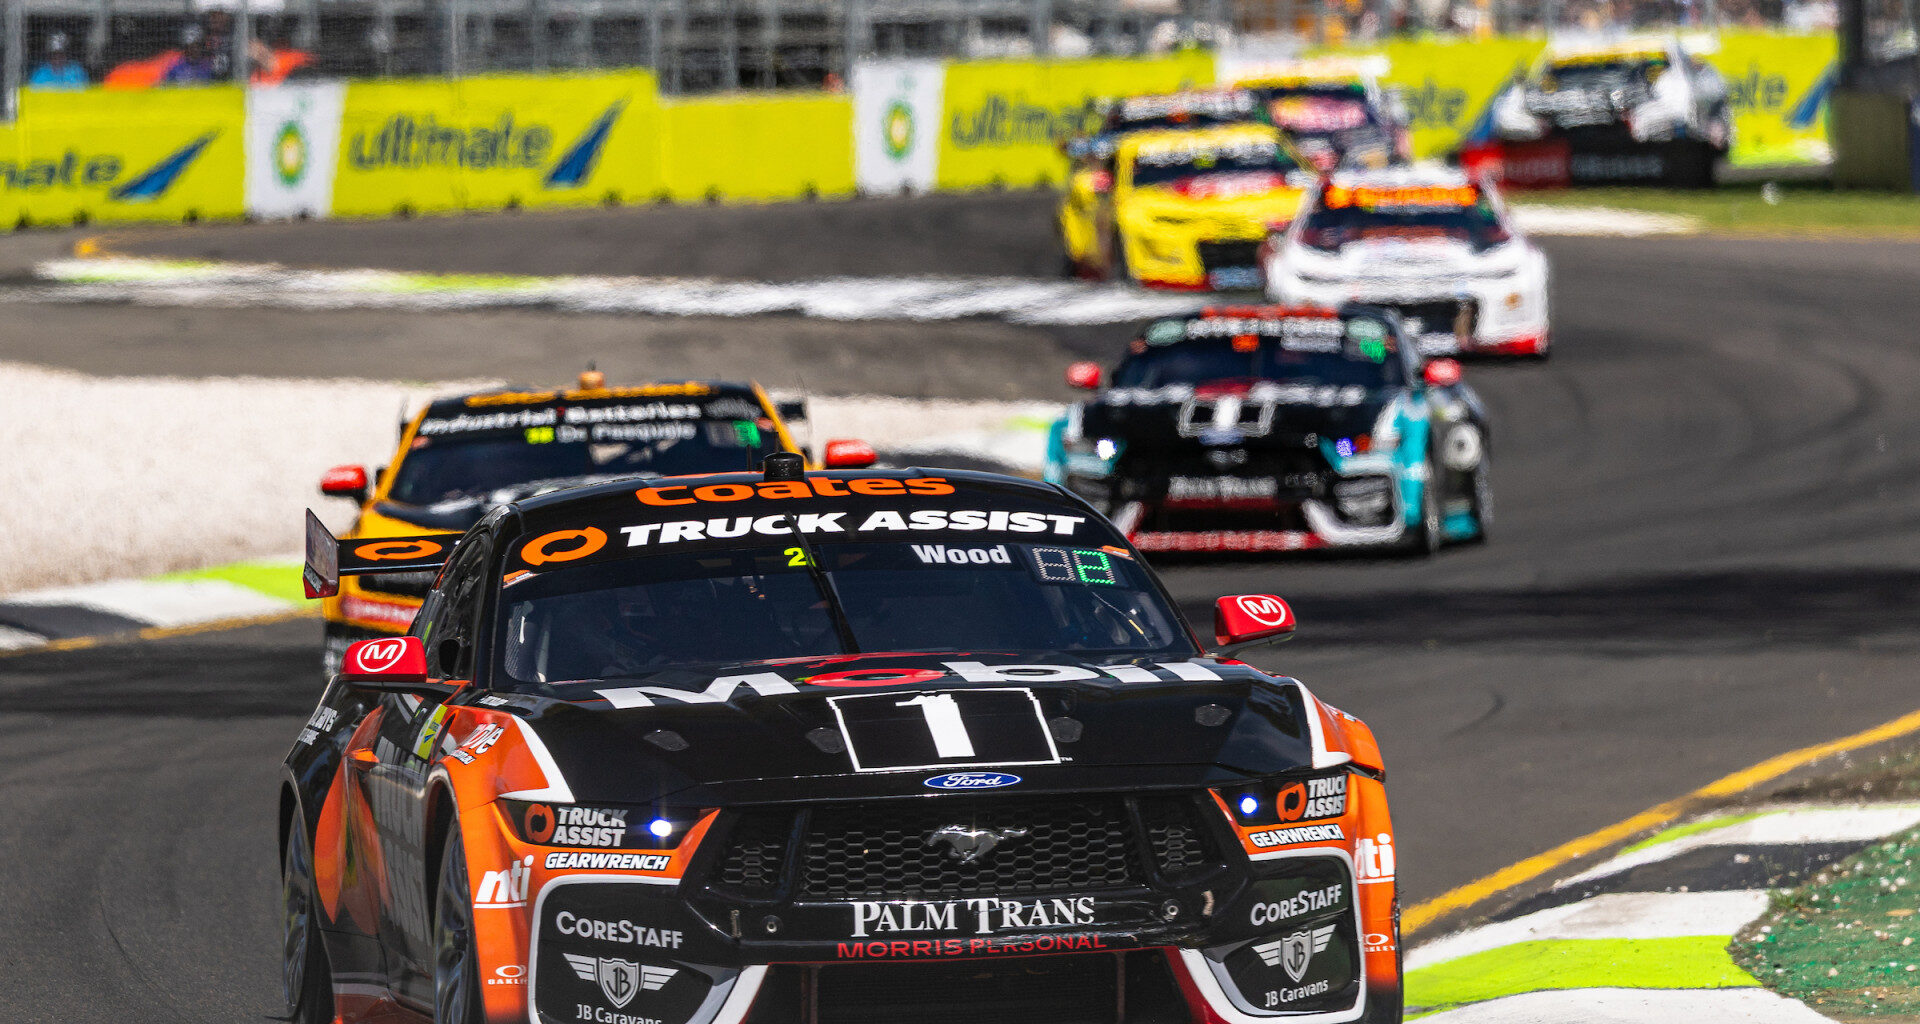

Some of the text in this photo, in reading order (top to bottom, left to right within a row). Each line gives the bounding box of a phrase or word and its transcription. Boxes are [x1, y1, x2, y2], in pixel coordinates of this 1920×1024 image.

[349, 110, 553, 170] ultimate
[620, 510, 1085, 547] TRUCK ASSIST
[911, 544, 1012, 564] Wood
[594, 660, 1222, 709] Mobil
[896, 693, 975, 759] 1
[943, 771, 1003, 788] Ford
[558, 807, 629, 828] TRUCK
[552, 826, 626, 847] ASSIST
[1249, 824, 1345, 848] GEARWRENCH
[545, 852, 671, 871] GEARWRENCH
[475, 855, 534, 903] nti
[838, 939, 963, 959] MORRIS
[1265, 980, 1329, 1008] JB Caravans
[576, 1004, 662, 1024] JB Caravans
